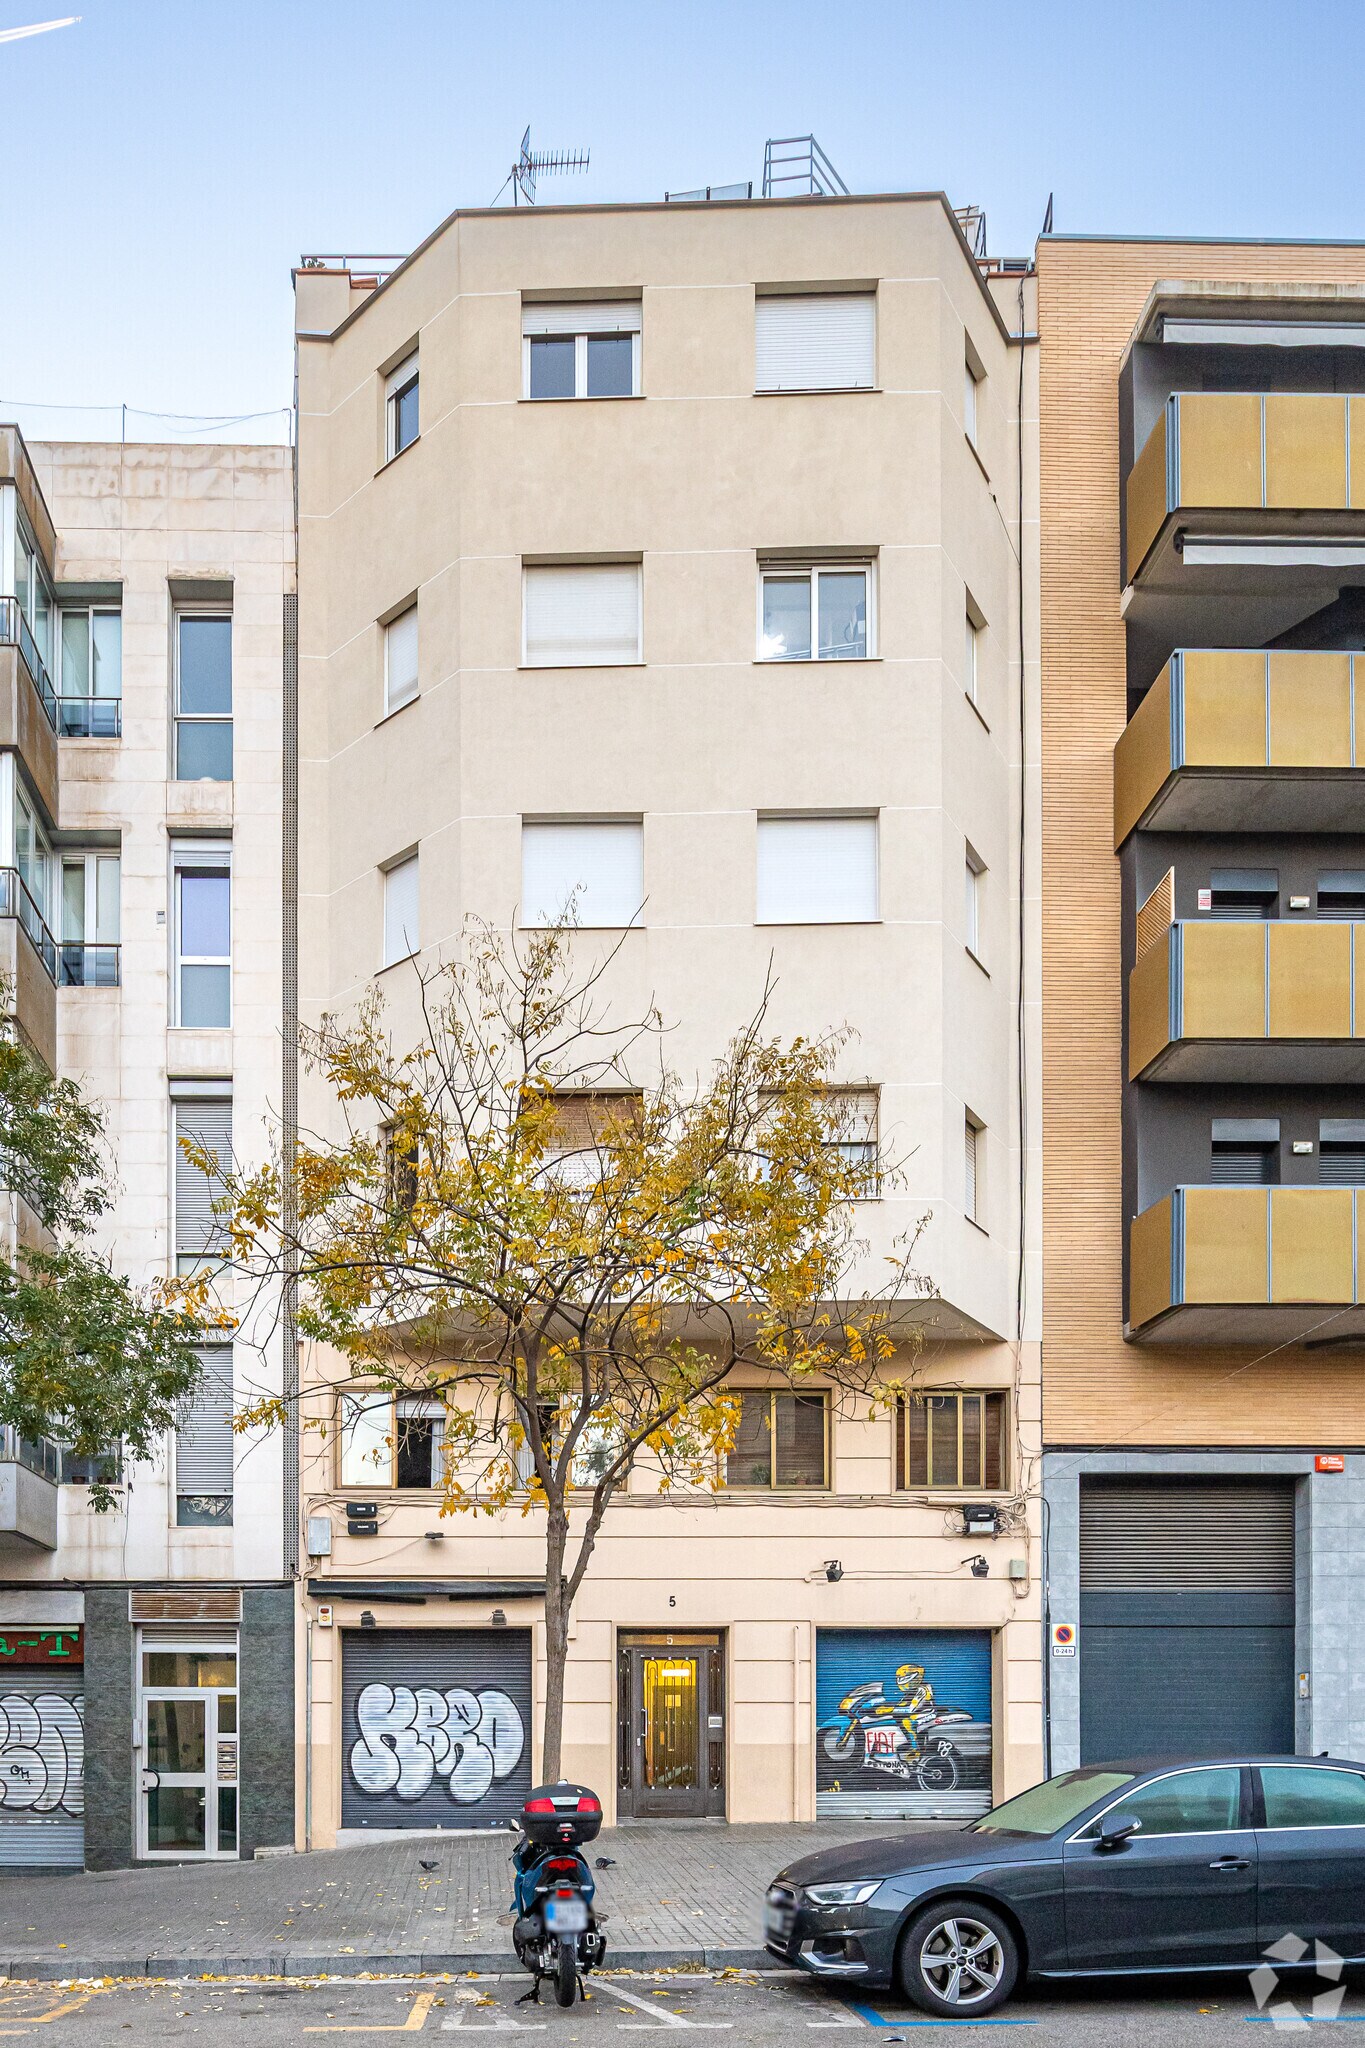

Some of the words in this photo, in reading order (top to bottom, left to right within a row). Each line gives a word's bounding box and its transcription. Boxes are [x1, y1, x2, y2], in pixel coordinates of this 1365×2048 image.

[669, 1595, 676, 1607] 5
[666, 1634, 674, 1645] 5
[866, 1731, 896, 1754] FIAT
